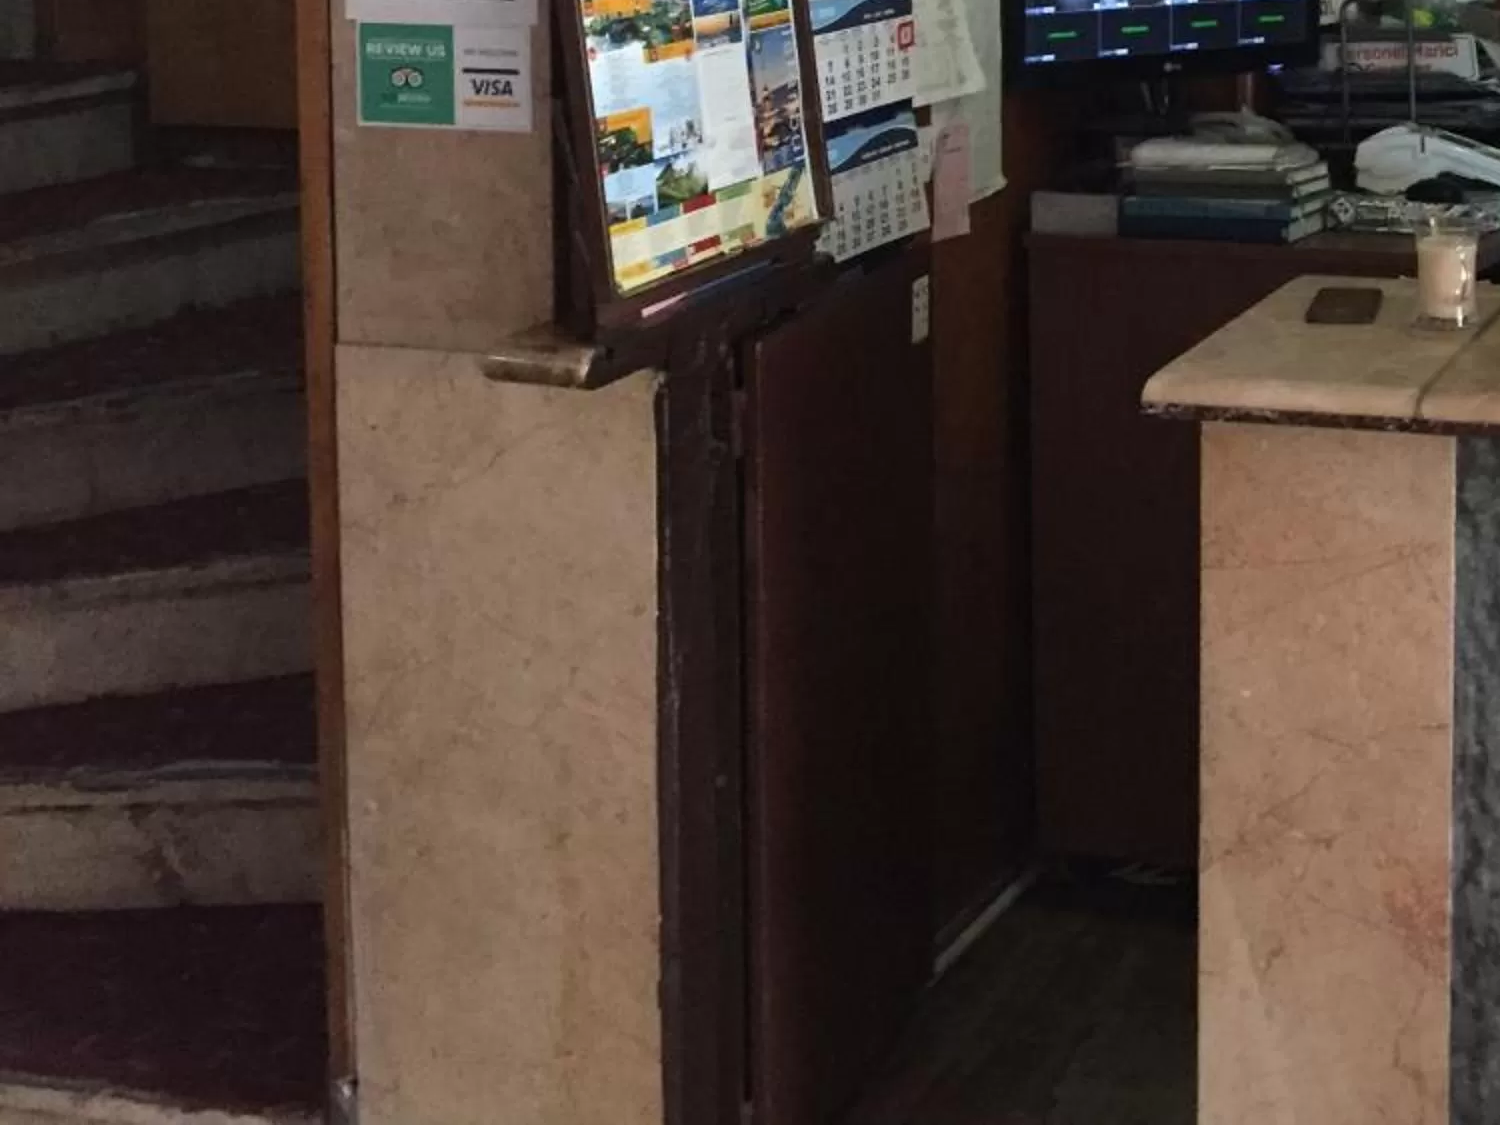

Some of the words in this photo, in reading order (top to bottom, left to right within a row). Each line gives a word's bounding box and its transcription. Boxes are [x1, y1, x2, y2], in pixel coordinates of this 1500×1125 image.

[365, 42, 421, 56] REVIEW
[427, 44, 446, 58] US
[470, 78, 513, 96] VISA
